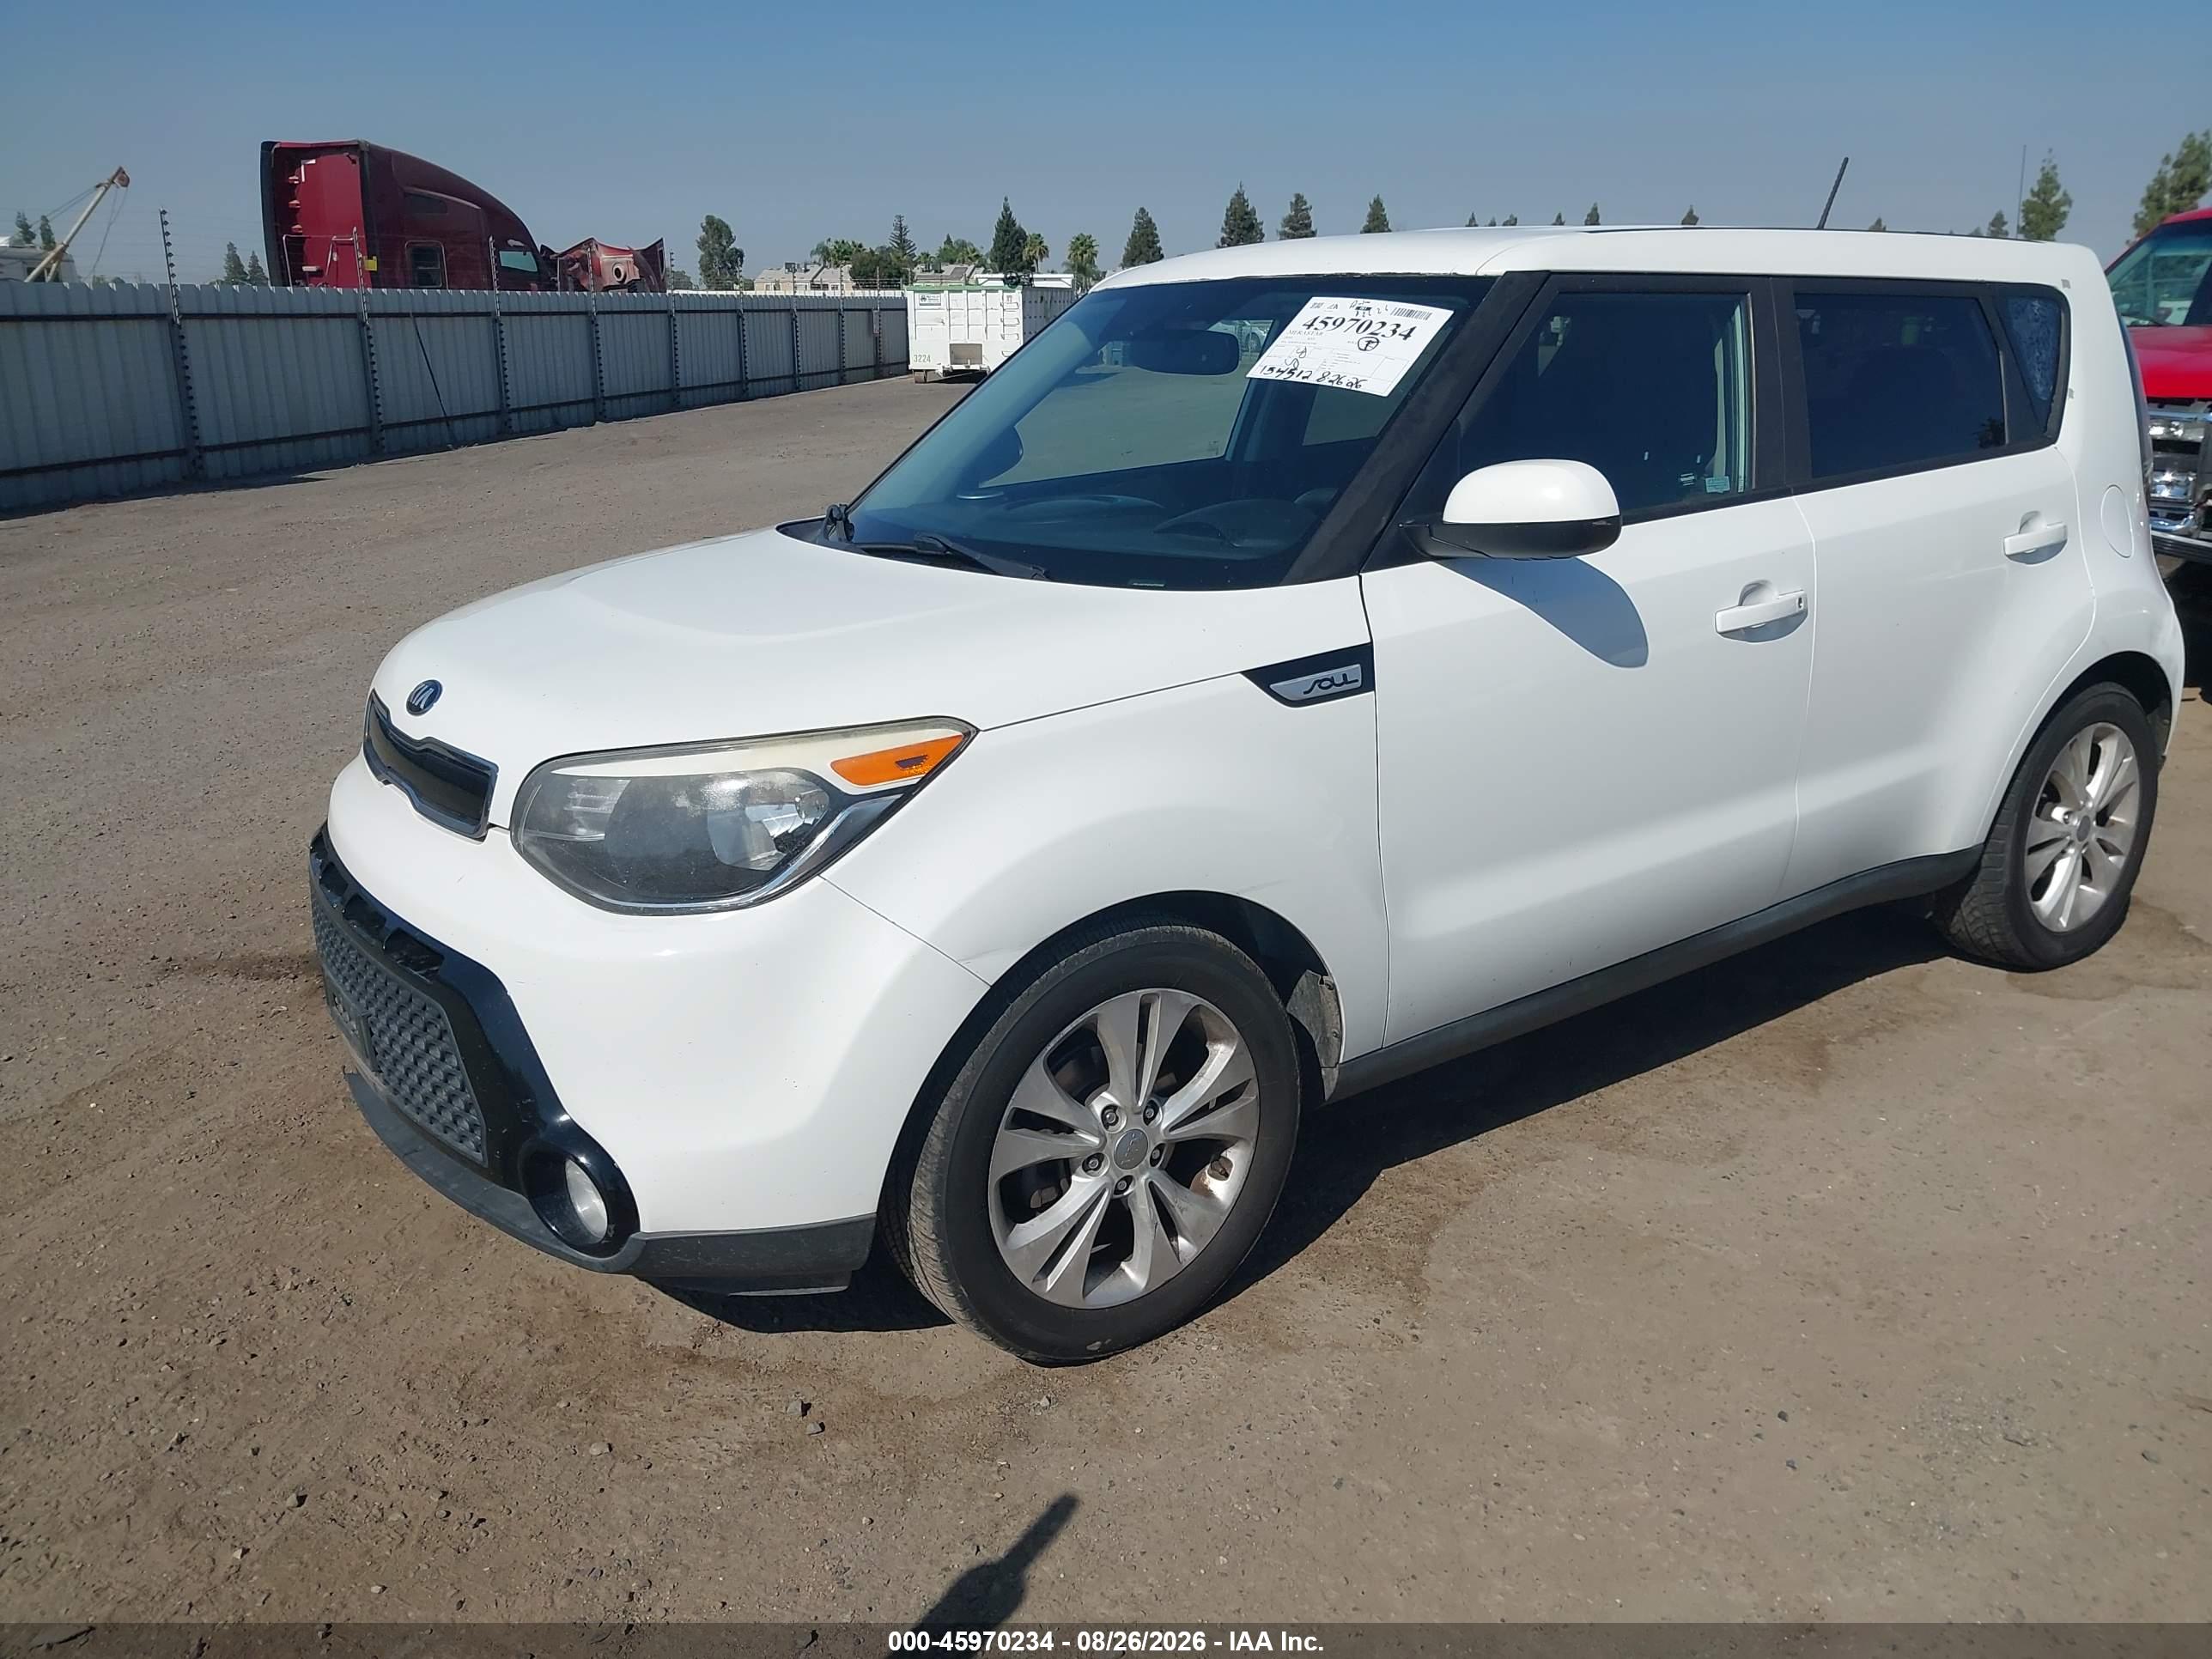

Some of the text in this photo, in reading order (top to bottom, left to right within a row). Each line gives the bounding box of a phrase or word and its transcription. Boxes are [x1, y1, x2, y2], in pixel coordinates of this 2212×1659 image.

[1302, 315, 1418, 341] 45970234
[913, 353, 932, 363] 3224
[1302, 672, 1359, 696] SOUL
